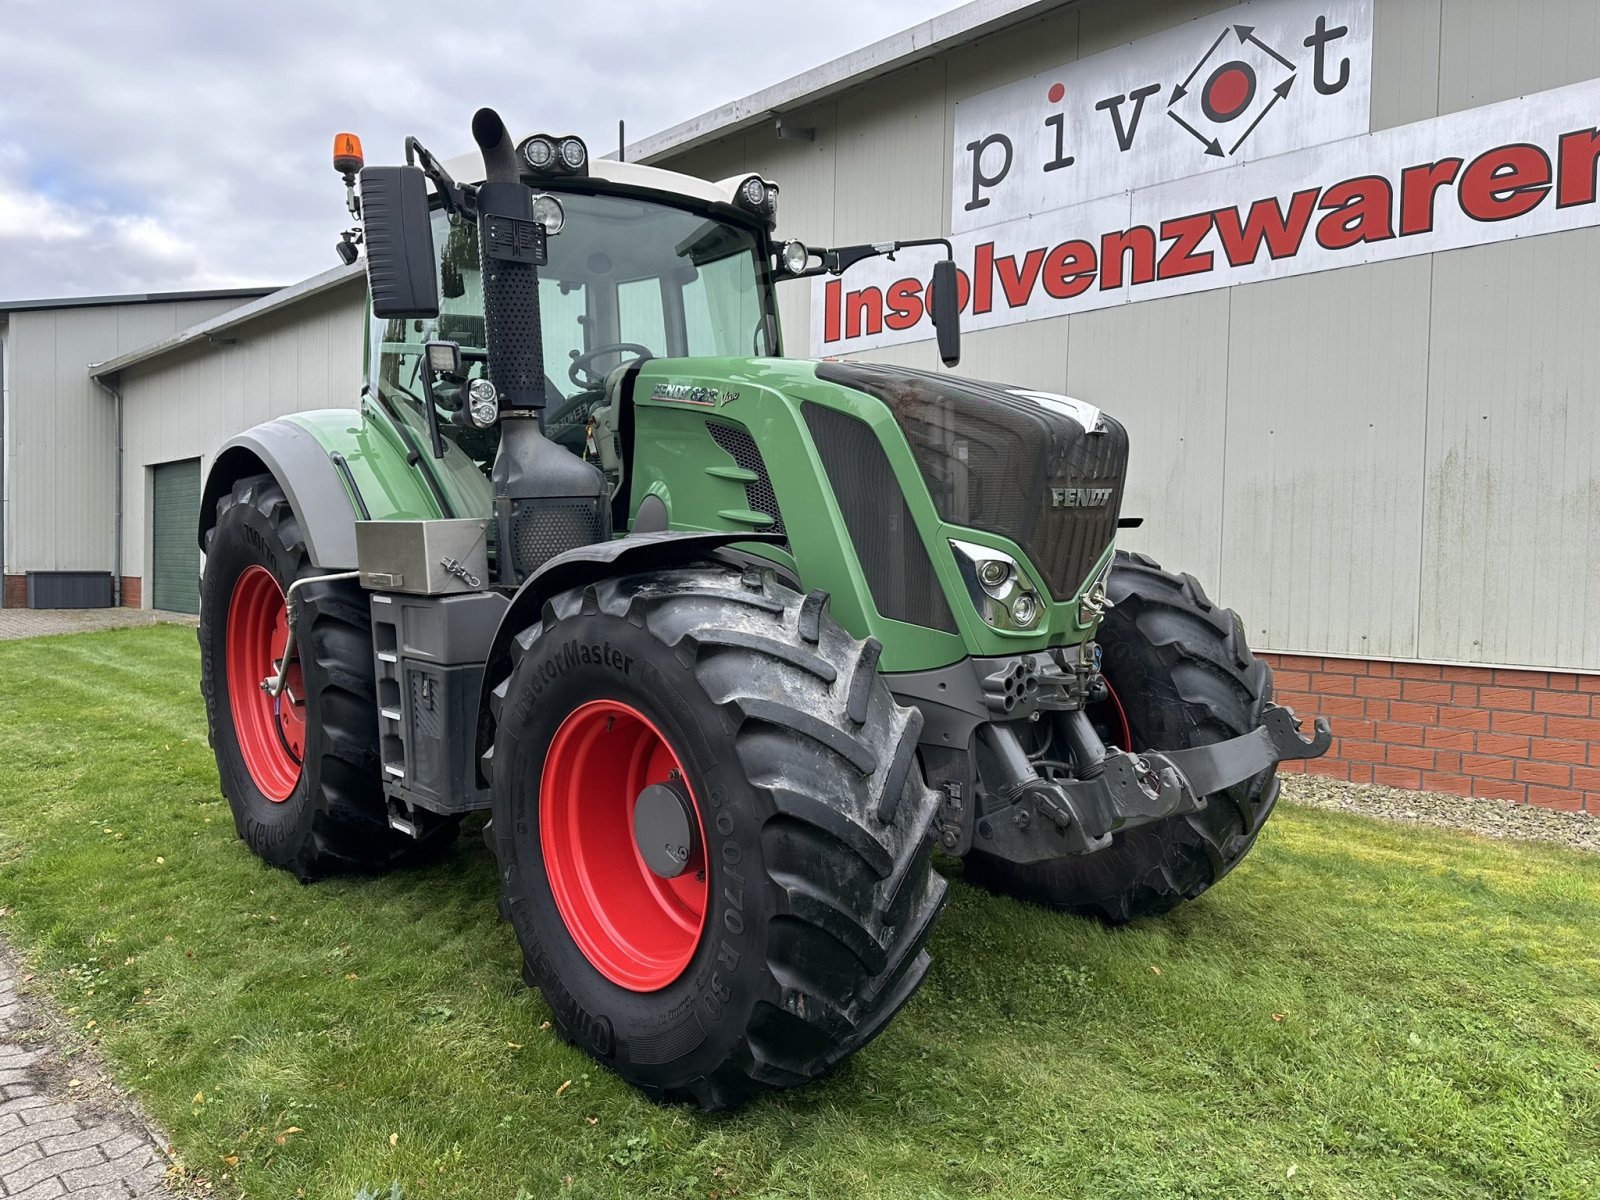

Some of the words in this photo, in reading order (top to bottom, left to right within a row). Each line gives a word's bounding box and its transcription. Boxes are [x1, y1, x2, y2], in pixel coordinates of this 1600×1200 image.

[964, 15, 1350, 210] pivot
[652, 383, 691, 400] FENDT
[1051, 487, 1113, 507] FENDT
[513, 639, 634, 727] TractorMaster
[711, 784, 745, 935] 600/70
[717, 941, 740, 972] R
[704, 971, 731, 1021] 30
